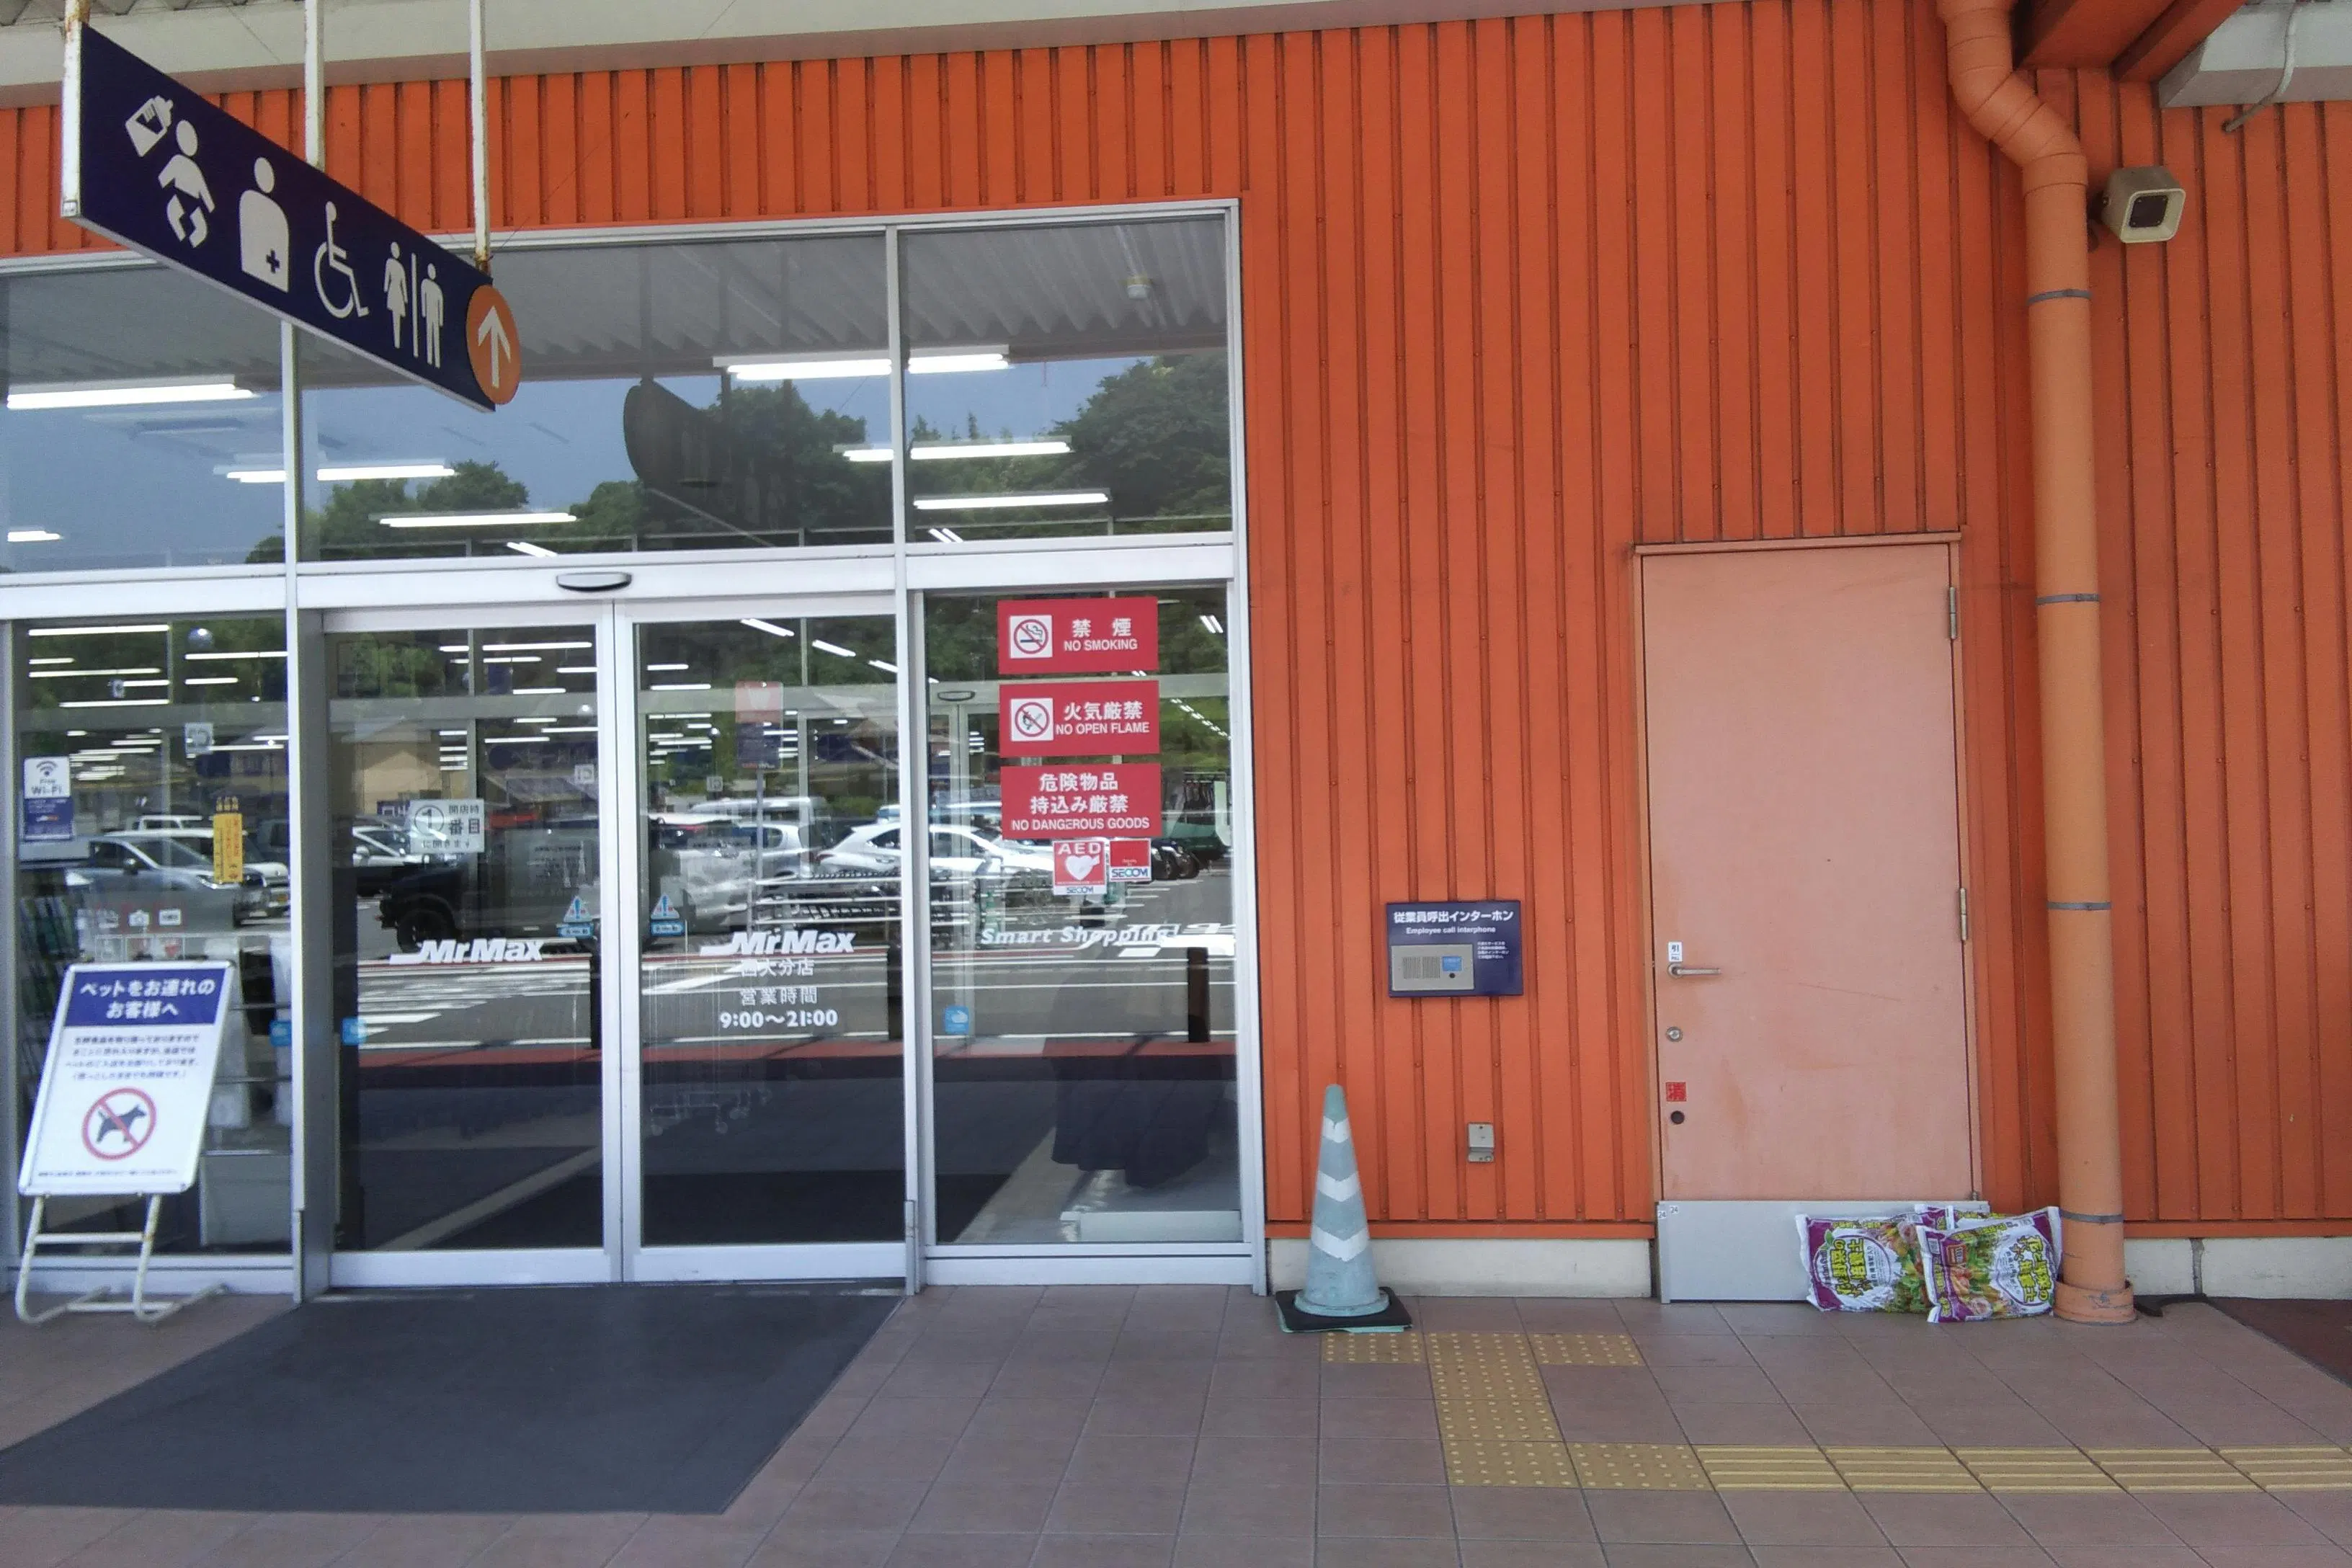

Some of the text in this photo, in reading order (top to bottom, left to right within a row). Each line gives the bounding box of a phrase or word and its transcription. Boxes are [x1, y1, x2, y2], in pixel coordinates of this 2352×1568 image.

[1072, 617, 1132, 638] 禁煙
[1064, 638, 1138, 651] NO SMOKING
[1064, 701, 1143, 721] 火気厳禁
[1056, 722, 1149, 736] NO OPEN FLAME
[1039, 772, 1118, 792] 危険物品
[1030, 795, 1128, 815] 持込み厳禁
[1012, 816, 1150, 832] NO DANGEROUS GOODS
[1058, 842, 1102, 855] AED
[1111, 868, 1148, 877] SECOM
[1394, 910, 1513, 923] 従業員呼出インターホン
[981, 928, 1054, 944] Smart
[1406, 927, 1441, 935] Employee
[80, 979, 215, 997] ペットをお連れの
[739, 986, 818, 1006] 営業時間
[106, 1000, 179, 1019] お客様へ
